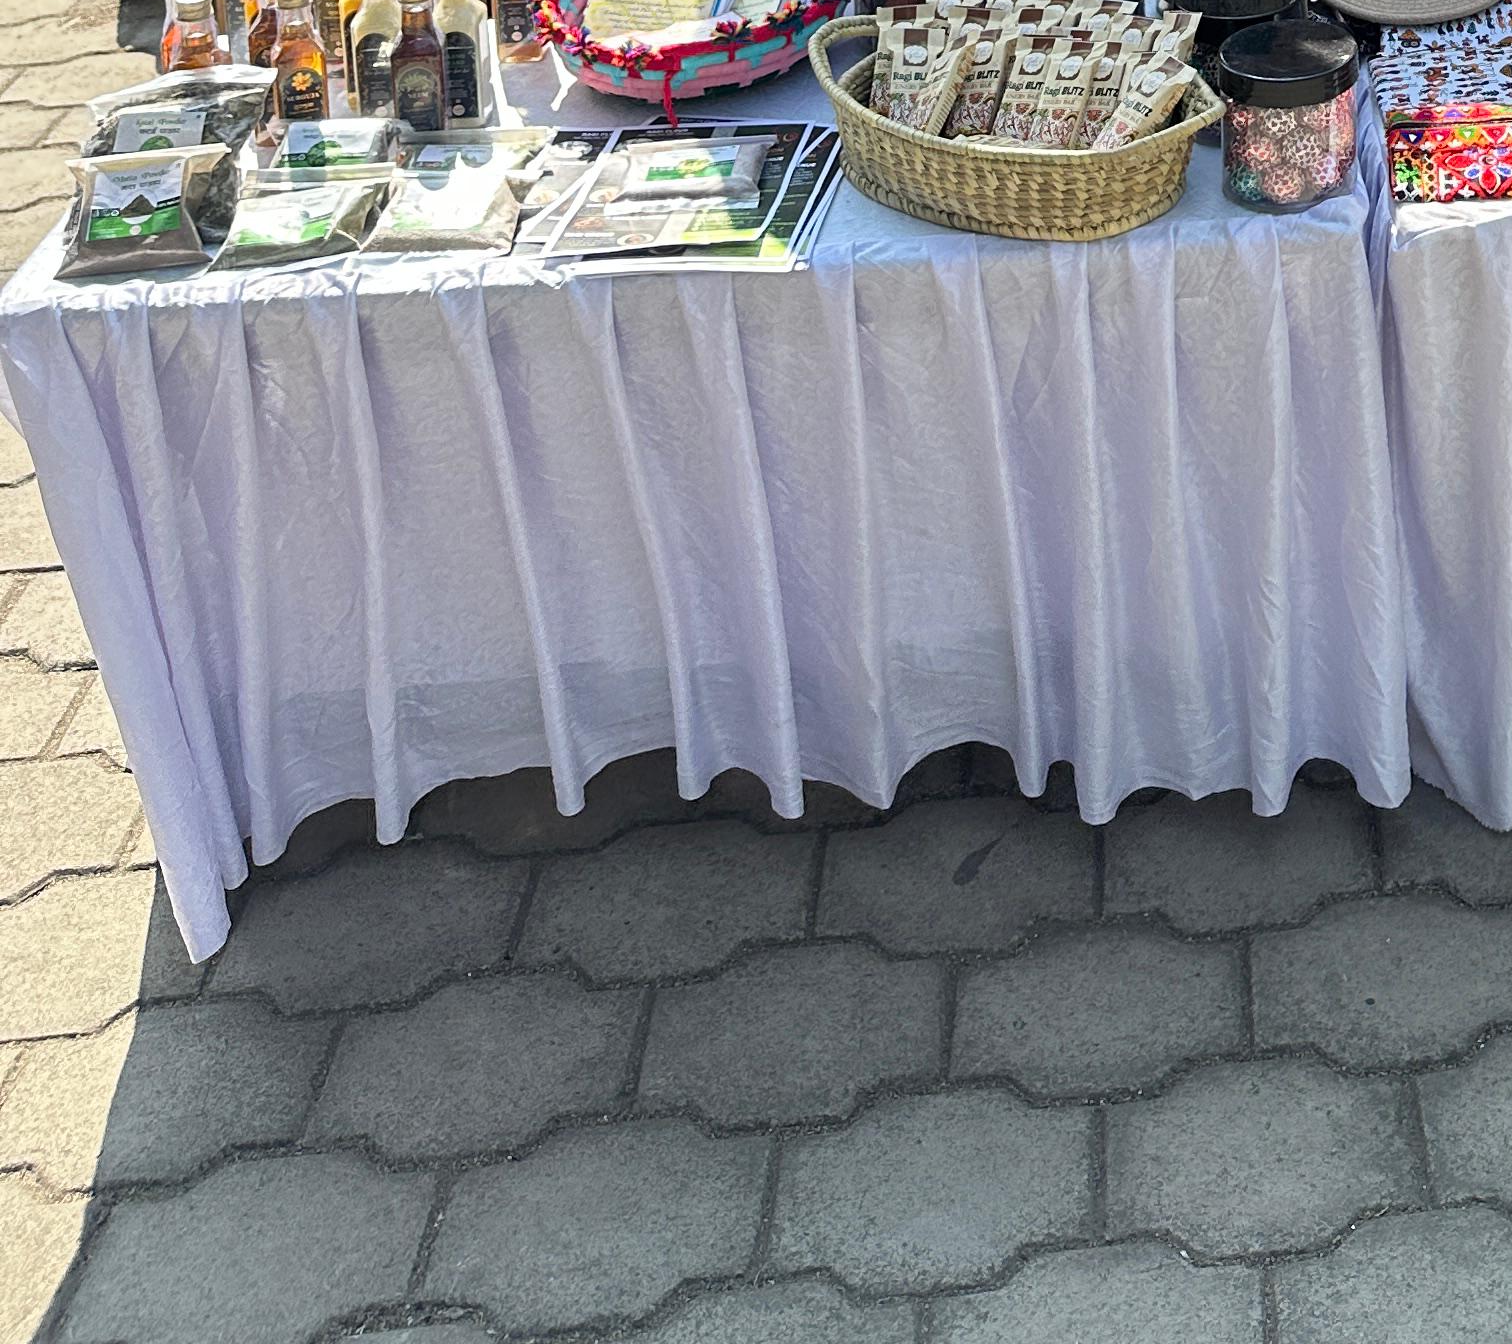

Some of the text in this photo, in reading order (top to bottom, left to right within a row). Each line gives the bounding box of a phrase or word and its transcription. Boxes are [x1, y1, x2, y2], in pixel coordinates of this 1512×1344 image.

[893, 72, 912, 82] Ragi
[976, 70, 1001, 80] BLITZ
[1025, 81, 1045, 90] BLIT
[1043, 87, 1061, 97] Ragi
[1061, 86, 1085, 97] BLITZ
